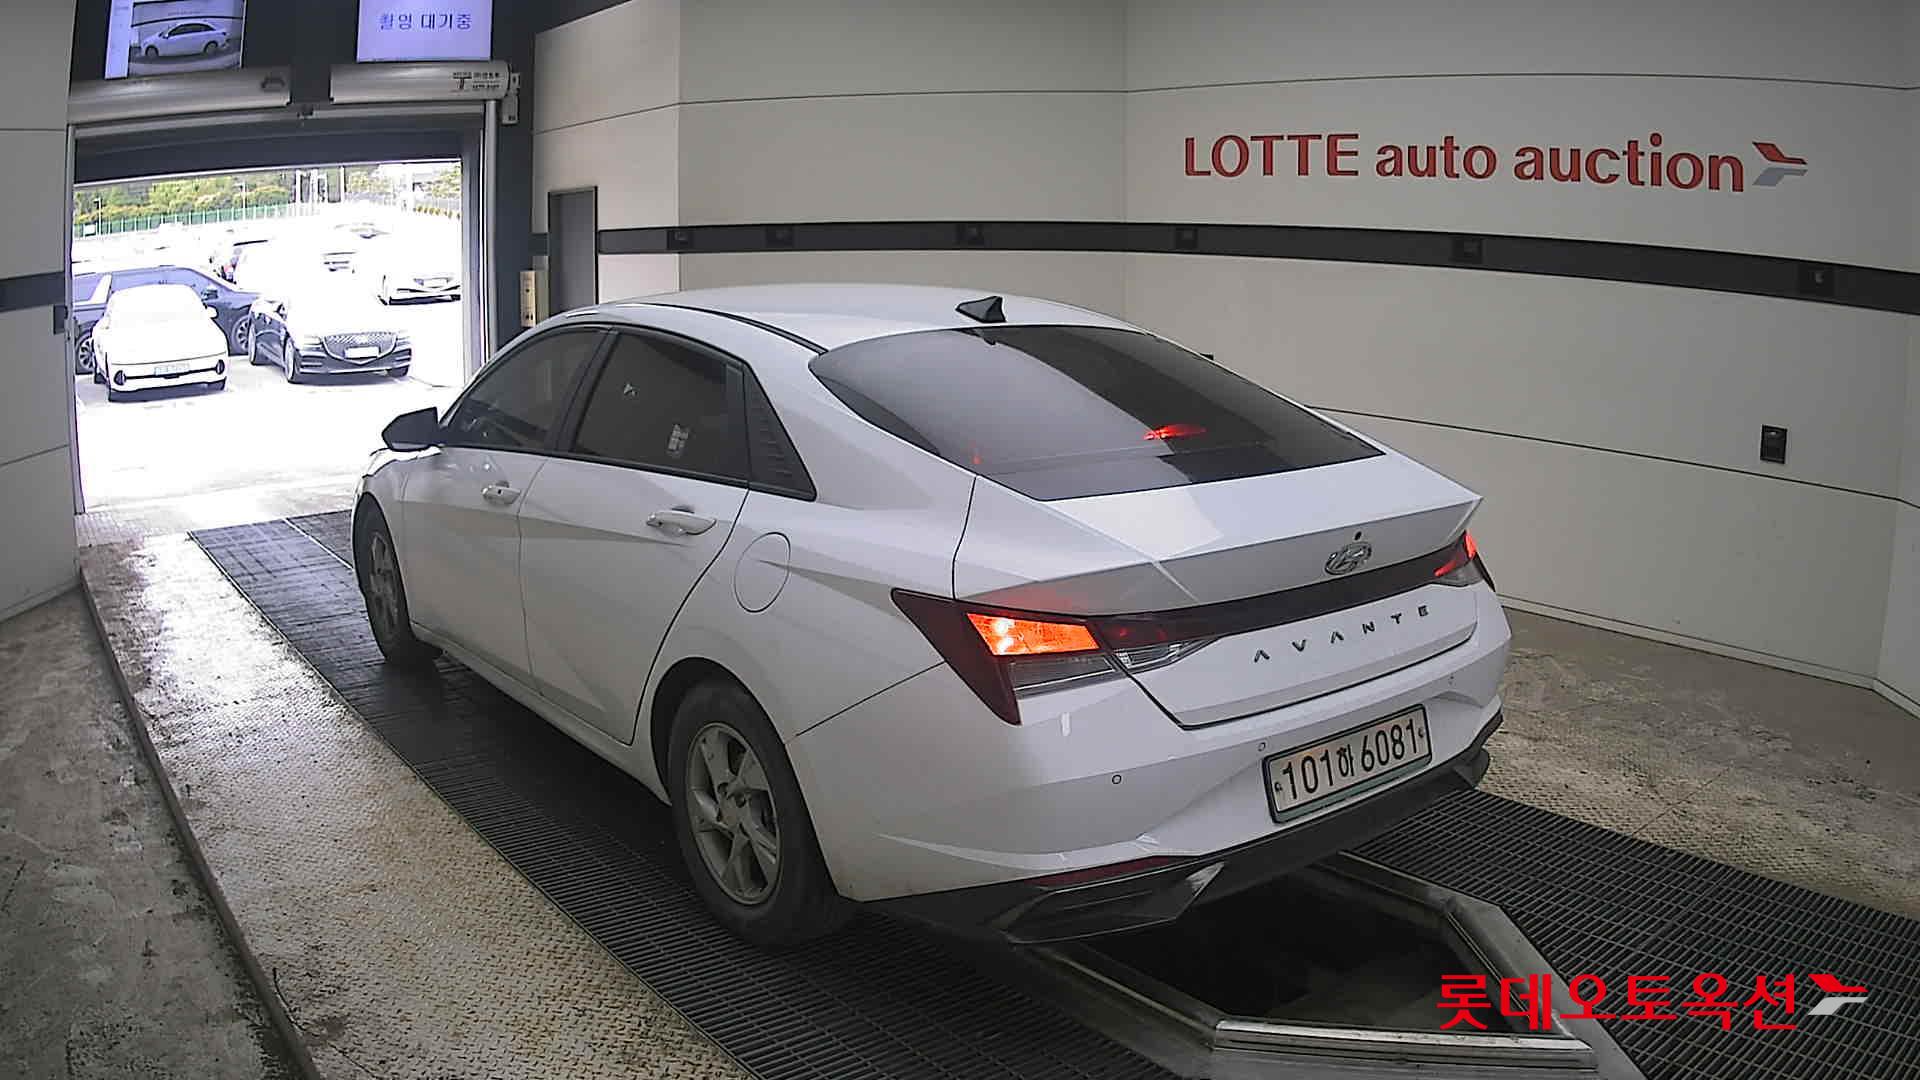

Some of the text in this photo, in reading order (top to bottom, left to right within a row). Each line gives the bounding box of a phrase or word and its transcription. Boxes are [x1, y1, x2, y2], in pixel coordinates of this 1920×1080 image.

[421, 13, 473, 31] 대기중
[1185, 133, 1743, 193] LOTTE auto auction
[1253, 604, 1430, 663] AVANTE
[1283, 718, 1418, 800] 101하 6081
